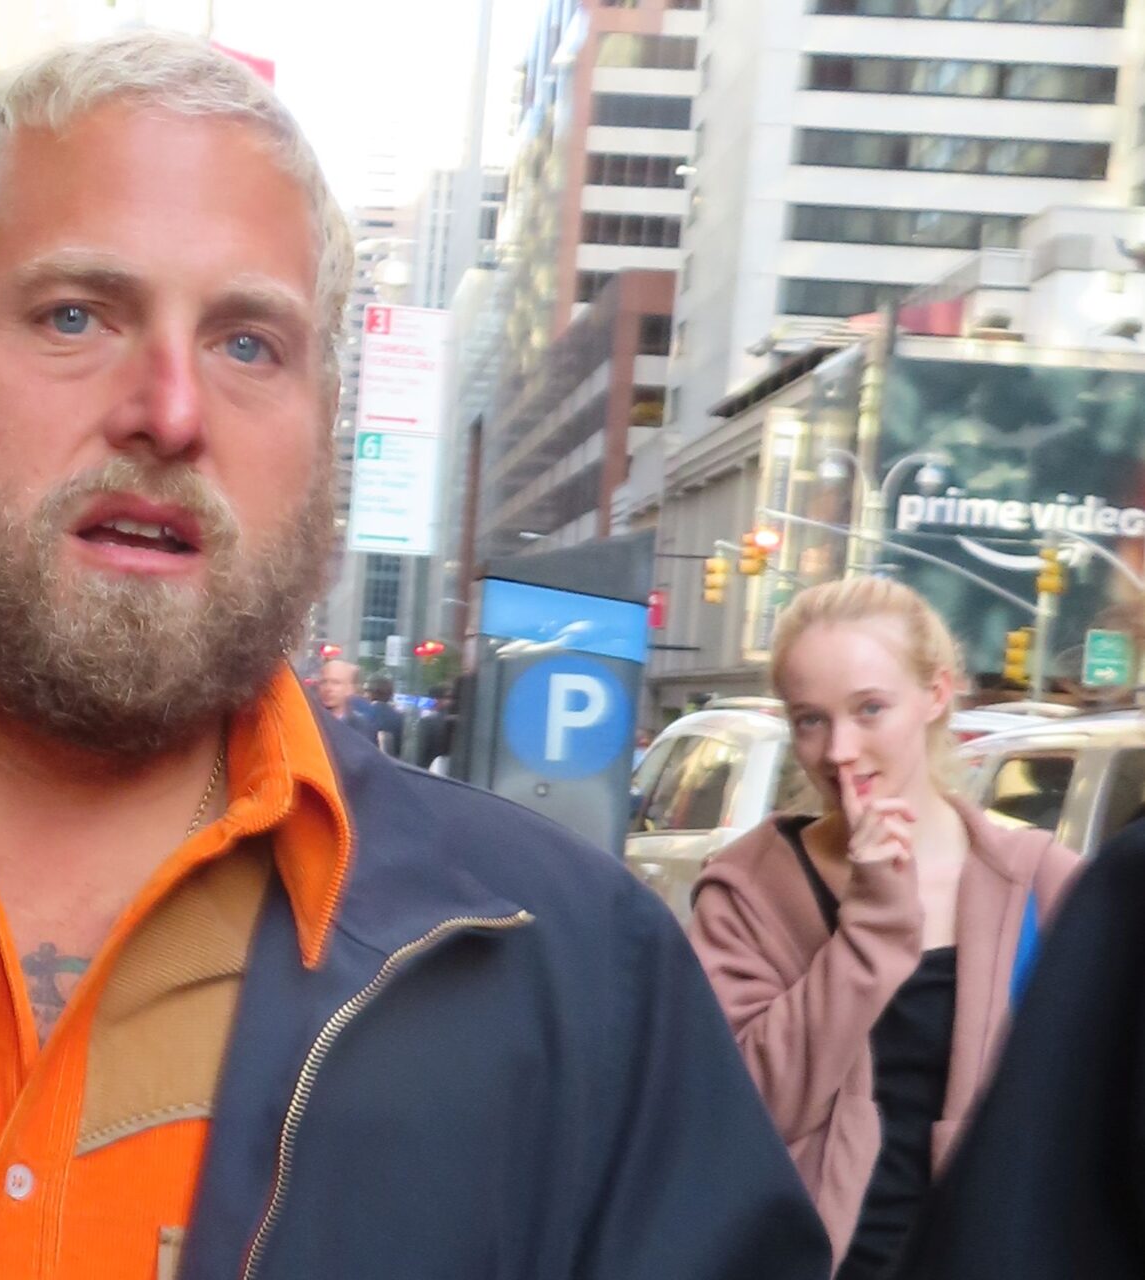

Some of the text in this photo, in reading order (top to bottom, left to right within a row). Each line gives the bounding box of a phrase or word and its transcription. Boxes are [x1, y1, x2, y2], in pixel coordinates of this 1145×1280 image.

[370, 308, 386, 333] 3
[362, 435, 379, 458] 6
[896, 486, 1145, 536] prime video
[545, 672, 608, 762] P
